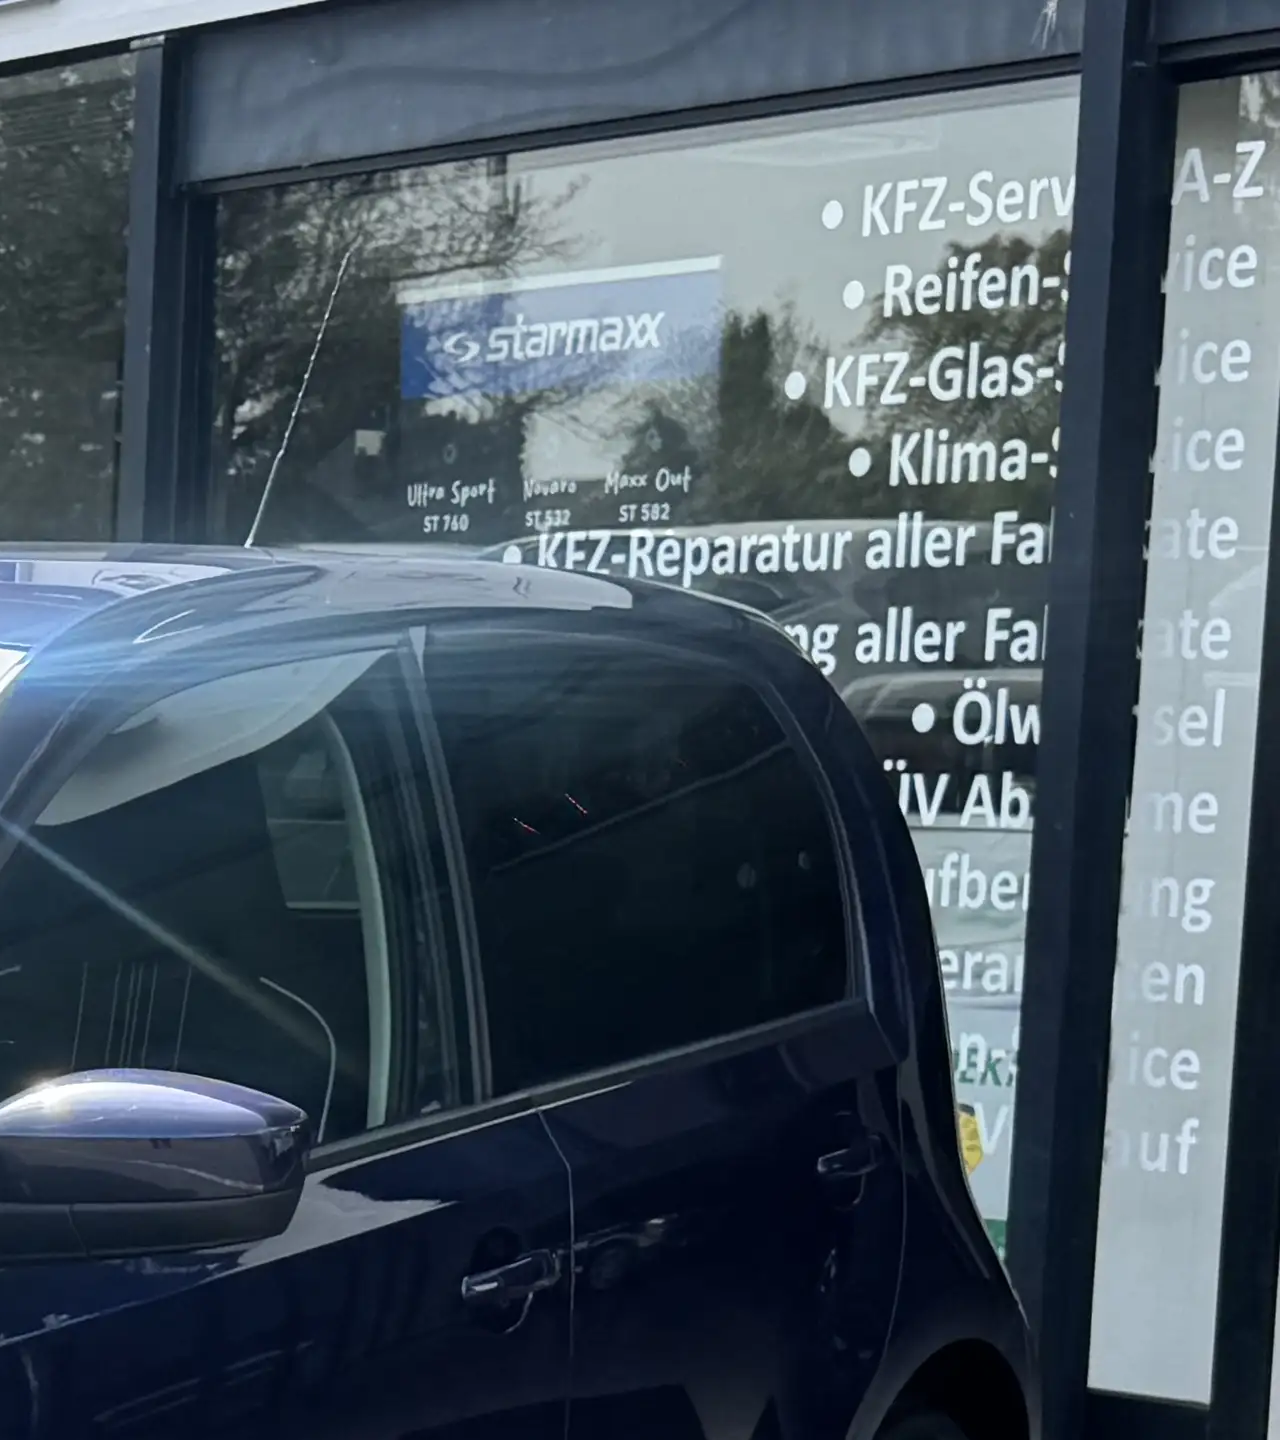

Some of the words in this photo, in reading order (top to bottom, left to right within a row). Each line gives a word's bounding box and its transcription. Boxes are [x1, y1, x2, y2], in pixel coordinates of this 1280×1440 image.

[862, 170, 1075, 237] KFZ-Serv
[1171, 140, 1266, 203] A-Z
[883, 250, 1071, 318] Reifen-
[1161, 234, 1258, 292] ice
[486, 312, 665, 361] starmaxx
[824, 341, 1065, 409] KFZ-Glas-
[1157, 327, 1251, 385] ice
[889, 426, 1060, 487] Klima-
[1150, 416, 1245, 473] ice
[407, 483, 444, 507] Ultra
[451, 478, 496, 507] Sport
[604, 468, 647, 495] Maxx
[655, 466, 692, 493] Out
[423, 517, 440, 533] ST
[443, 515, 470, 532] 760
[525, 511, 543, 528] ST
[545, 510, 571, 527] 532
[619, 505, 638, 522] ST
[641, 503, 670, 521] 582
[538, 527, 852, 588] KFZ-Reparatur
[866, 512, 976, 569] aller
[991, 510, 1053, 566] Fa
[1144, 508, 1239, 560] ate
[784, 623, 837, 676] ng
[855, 606, 966, 664] aller
[985, 605, 1049, 662] Fa
[1137, 608, 1232, 660] ate
[952, 678, 1040, 745] Ölw
[1151, 688, 1226, 747] sel
[960, 771, 1030, 828] Ab
[1149, 876, 1216, 933] ng
[1140, 960, 1205, 1006] en
[1127, 1029, 1201, 1091] ice
